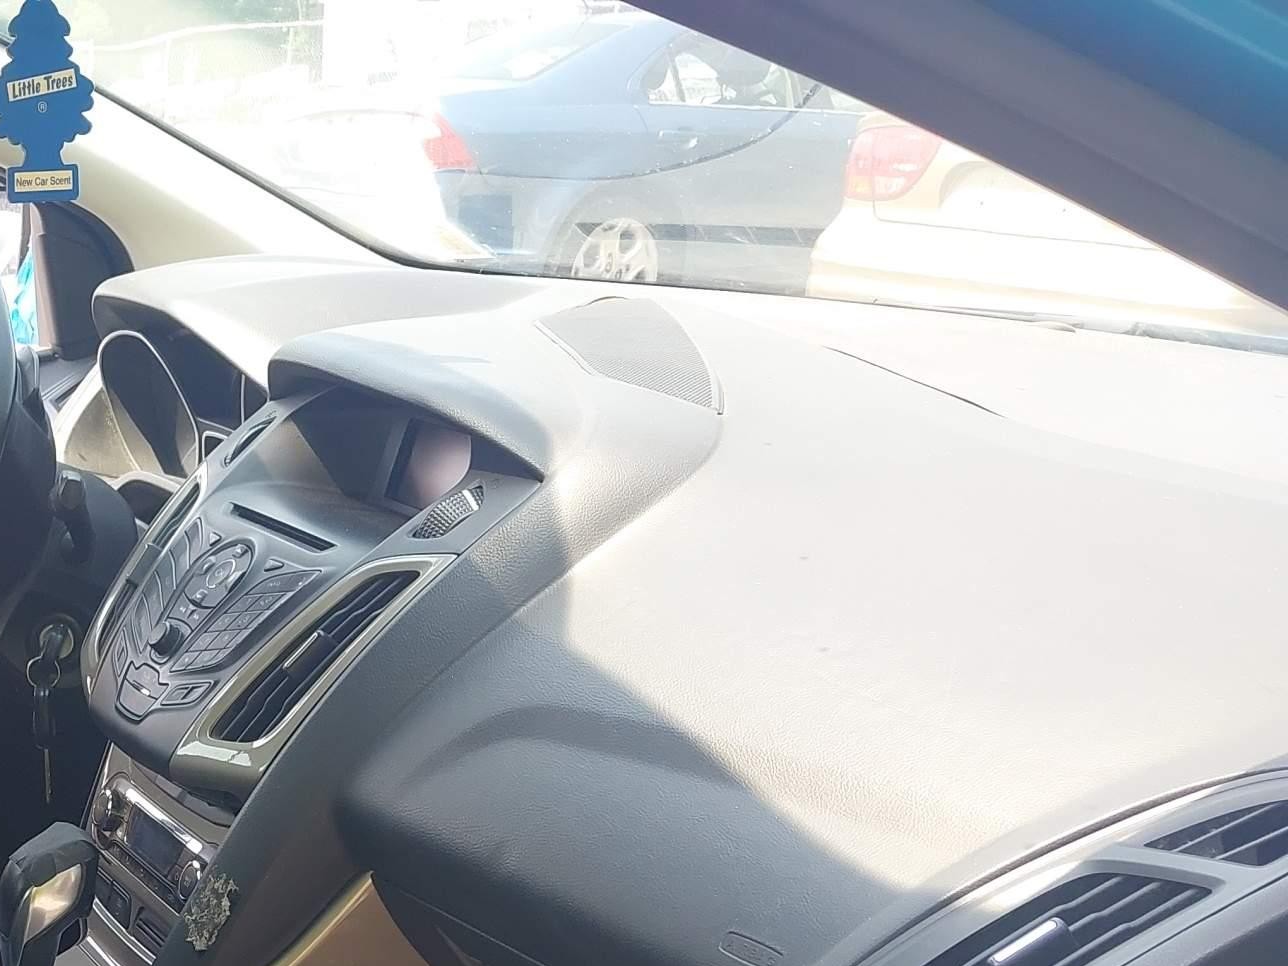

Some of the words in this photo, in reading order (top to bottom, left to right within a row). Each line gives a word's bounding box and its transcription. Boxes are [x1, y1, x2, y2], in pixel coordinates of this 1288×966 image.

[12, 79, 41, 99] Little
[43, 75, 73, 92] Trees
[16, 176, 32, 188] New
[34, 176, 48, 186] Car
[50, 175, 71, 186] Scent
